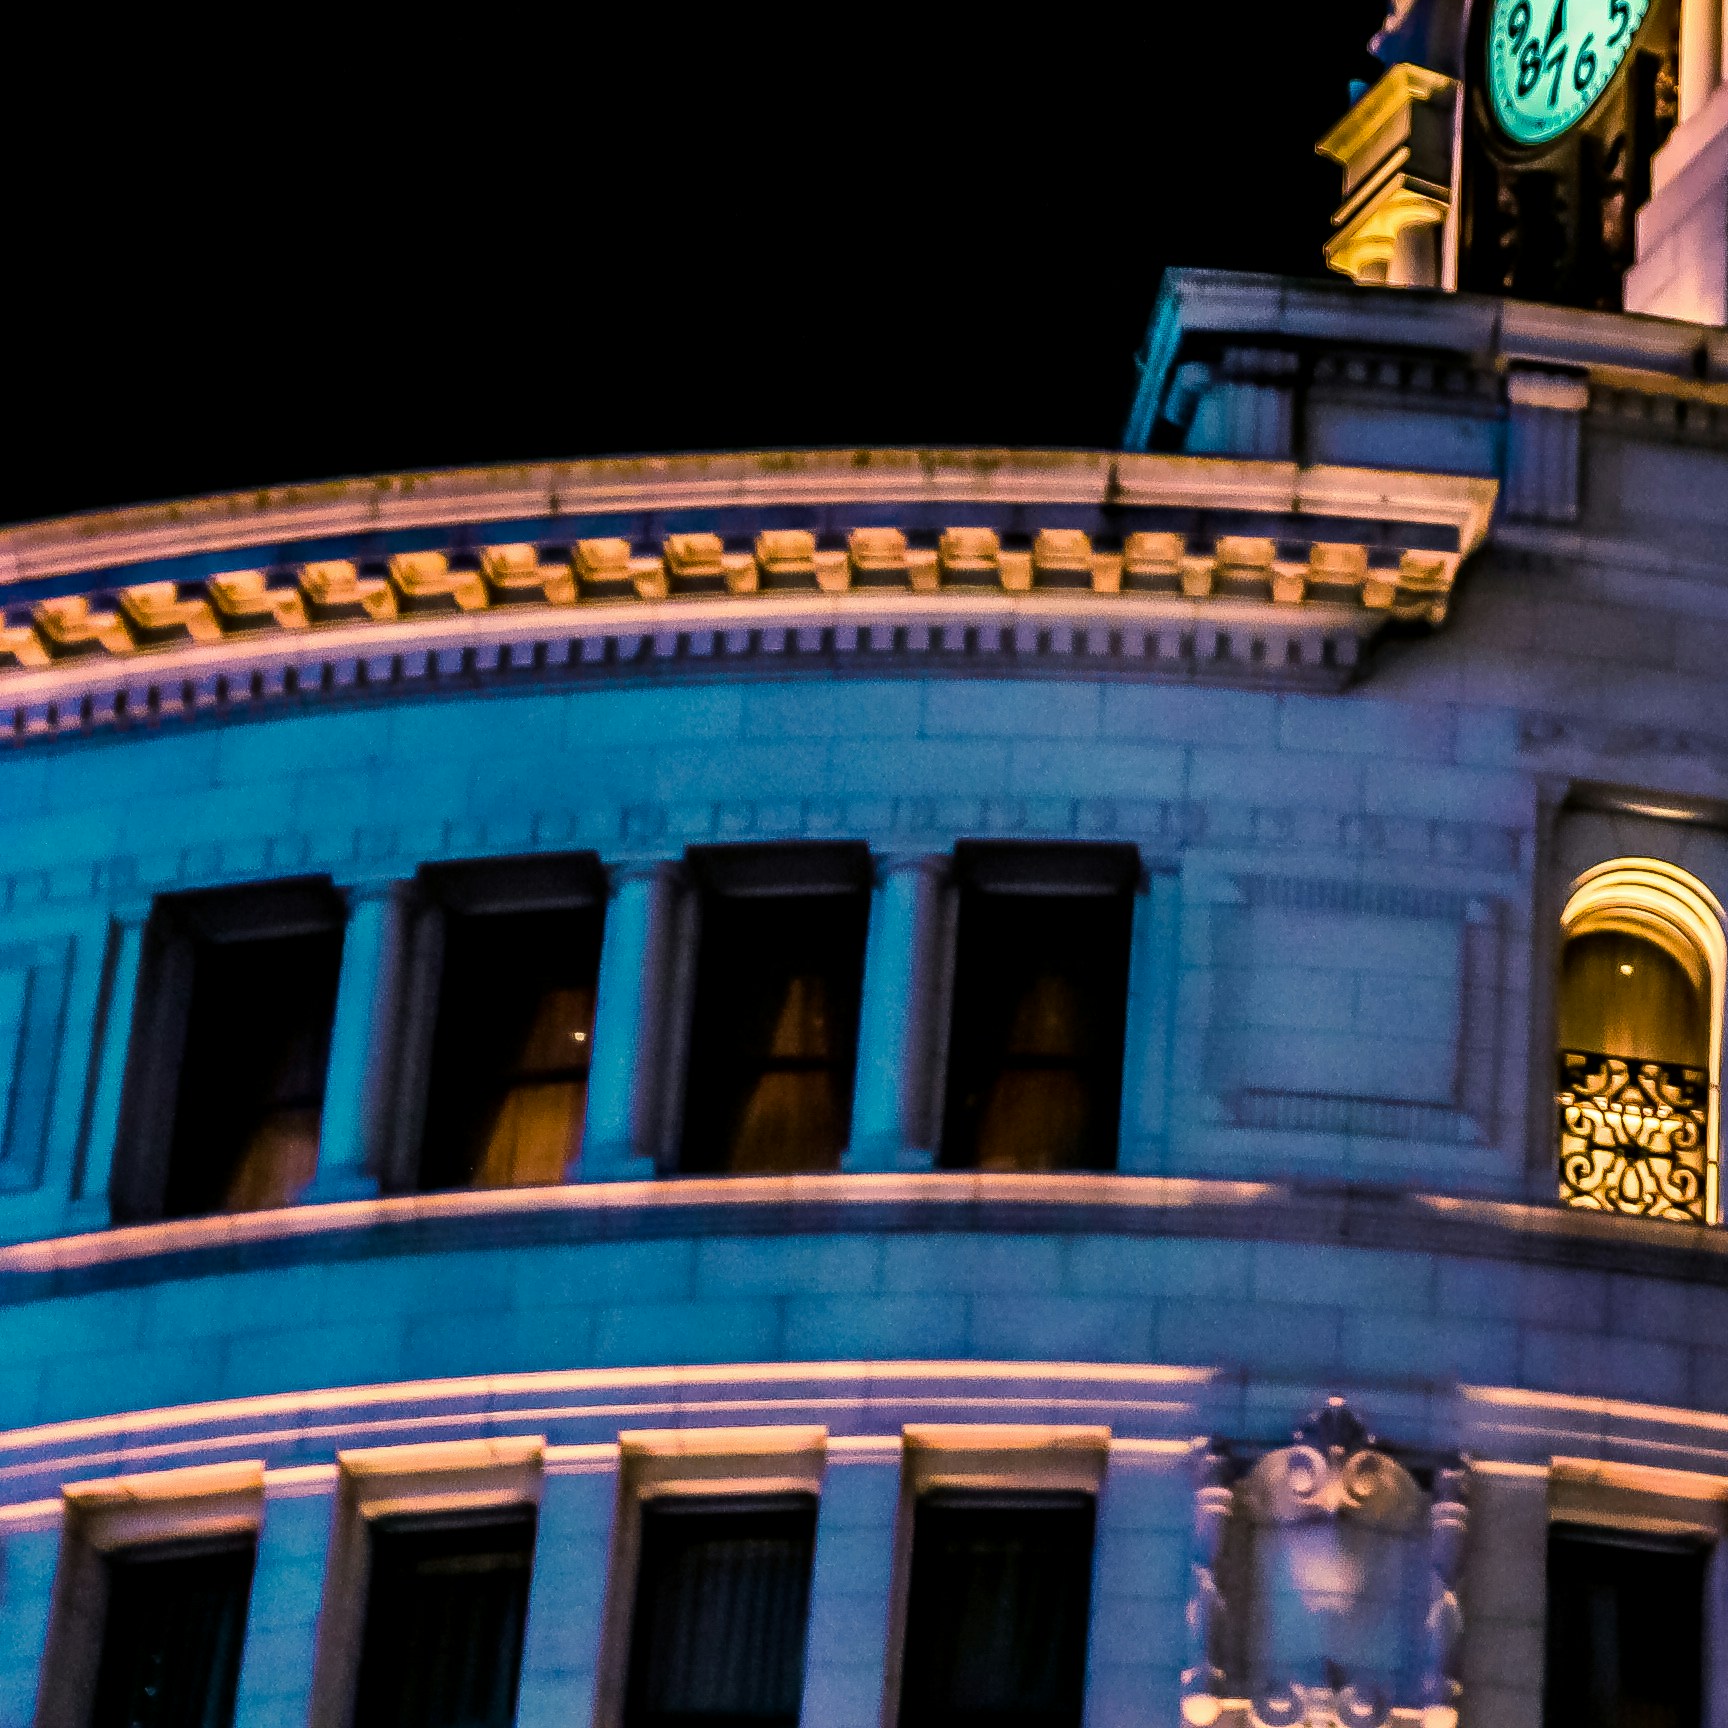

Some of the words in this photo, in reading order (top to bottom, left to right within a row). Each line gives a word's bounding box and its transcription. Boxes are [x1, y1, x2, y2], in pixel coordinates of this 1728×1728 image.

[1518, 38, 1542, 97] 8
[1543, 43, 1568, 108] 7
[1574, 32, 1596, 91] 6
